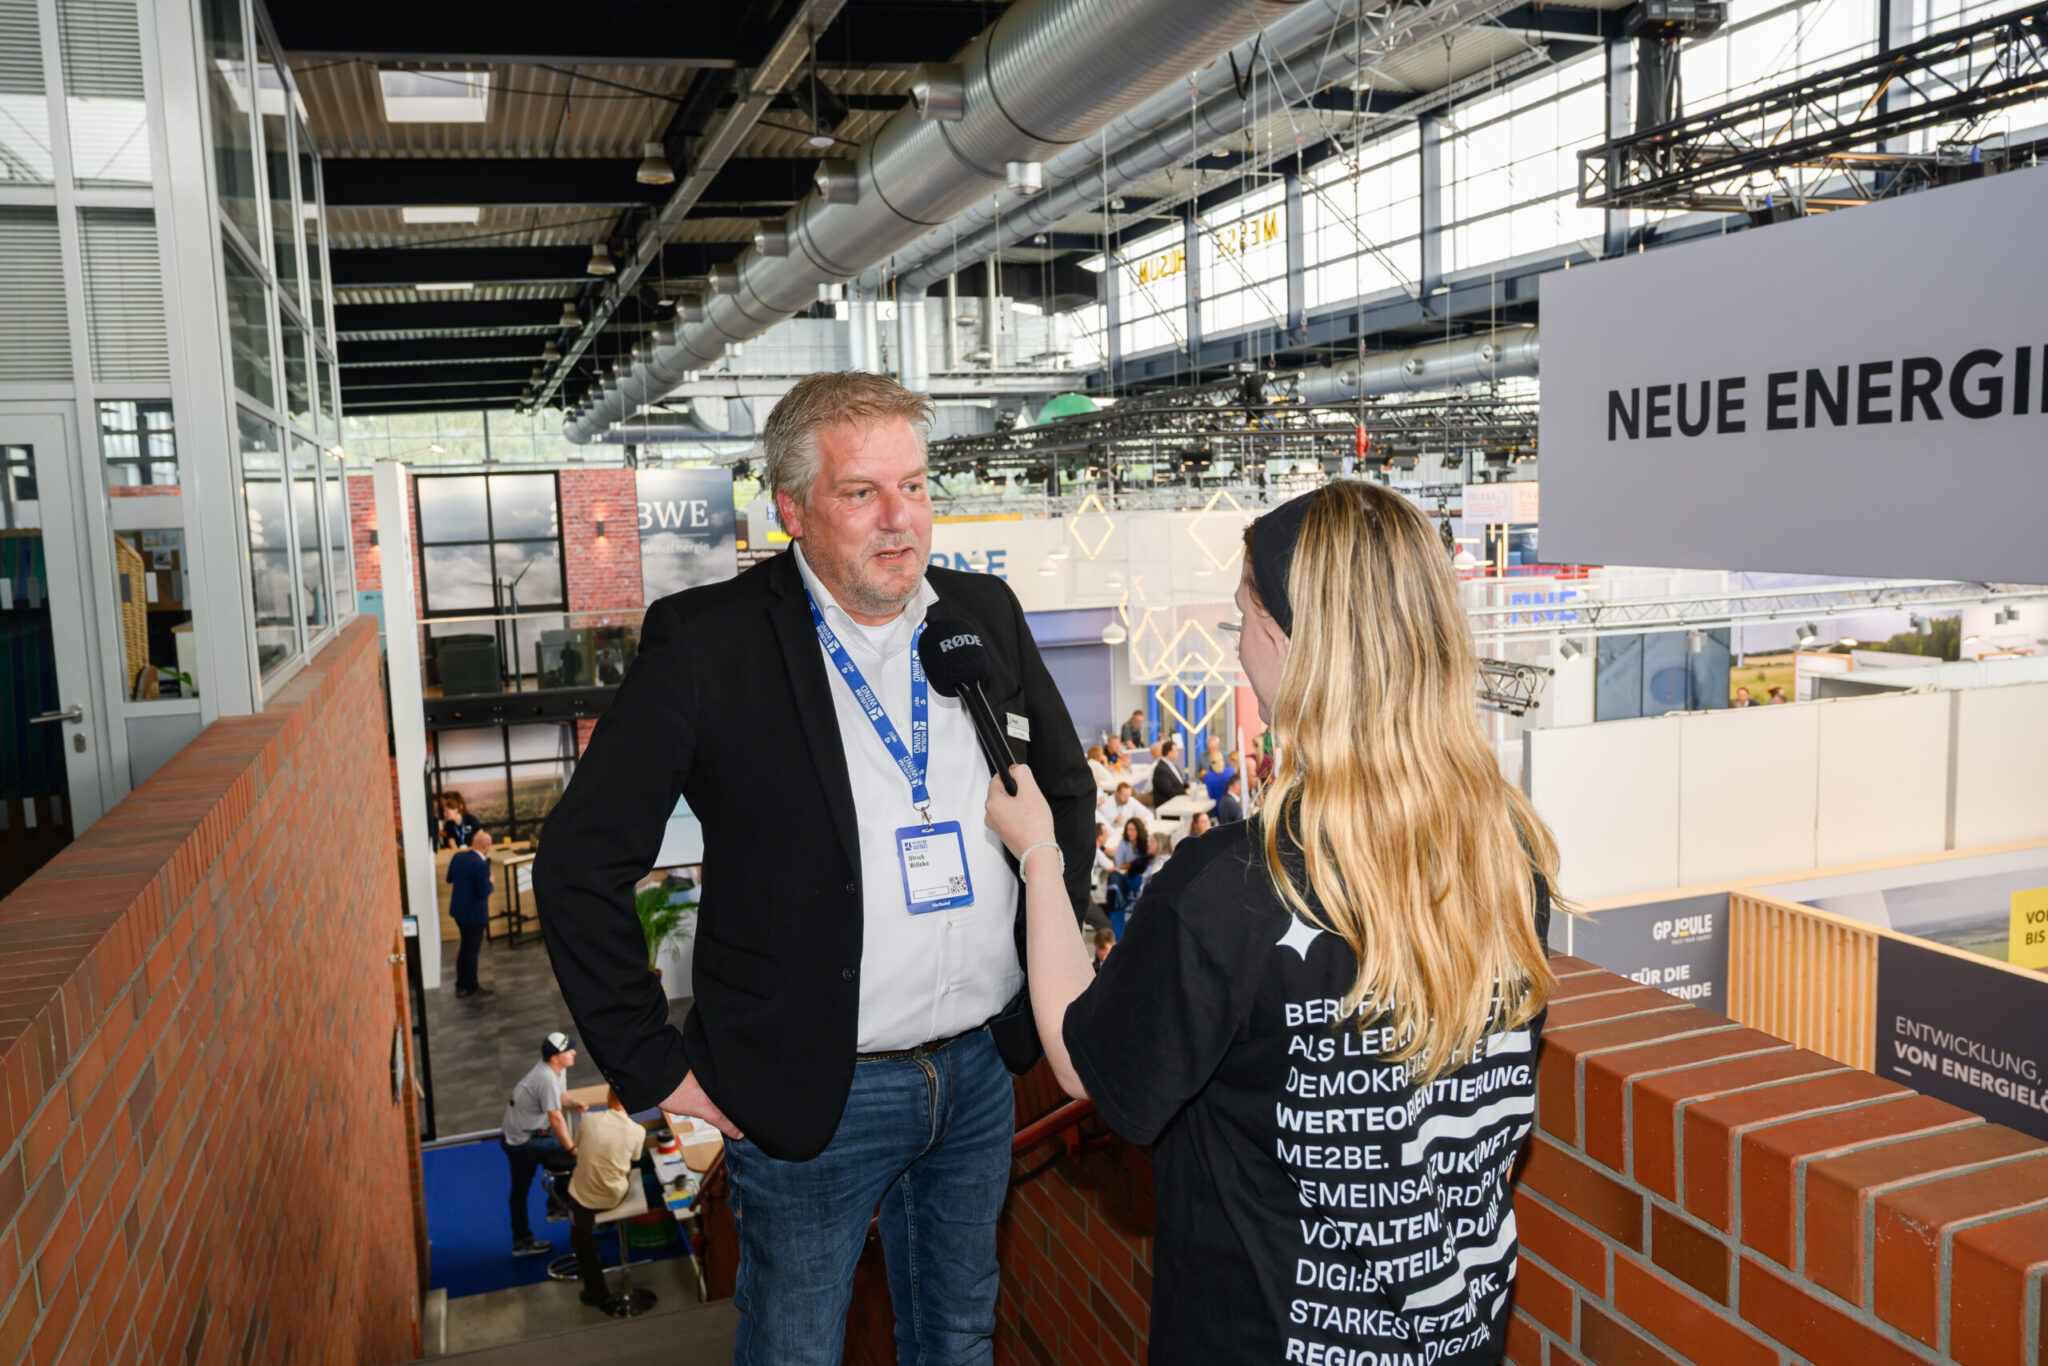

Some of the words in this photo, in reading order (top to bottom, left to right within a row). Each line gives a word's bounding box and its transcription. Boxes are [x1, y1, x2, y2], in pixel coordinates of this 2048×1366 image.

[1607, 376, 1746, 440] NEUE
[637, 499, 709, 529] BWE
[1511, 590, 1578, 625] PNE
[940, 634, 983, 653] RØDE
[860, 685, 878, 708] WIND
[913, 732, 921, 754] WIND
[903, 755, 919, 778] WIND
[1653, 920, 1672, 941] GP
[1671, 914, 1713, 938] JOULE
[2026, 910, 2048, 924] VO
[2025, 930, 2046, 945] BIS
[1631, 967, 1662, 985] FÜR
[1664, 964, 1690, 982] DIE
[1661, 981, 1713, 1000] ENDE
[1288, 1034, 1336, 1062] ALS
[1894, 1040, 1937, 1071] VON
[1276, 1138, 1390, 1169] ME2BE.
[1290, 1299, 1410, 1340] STARKES
